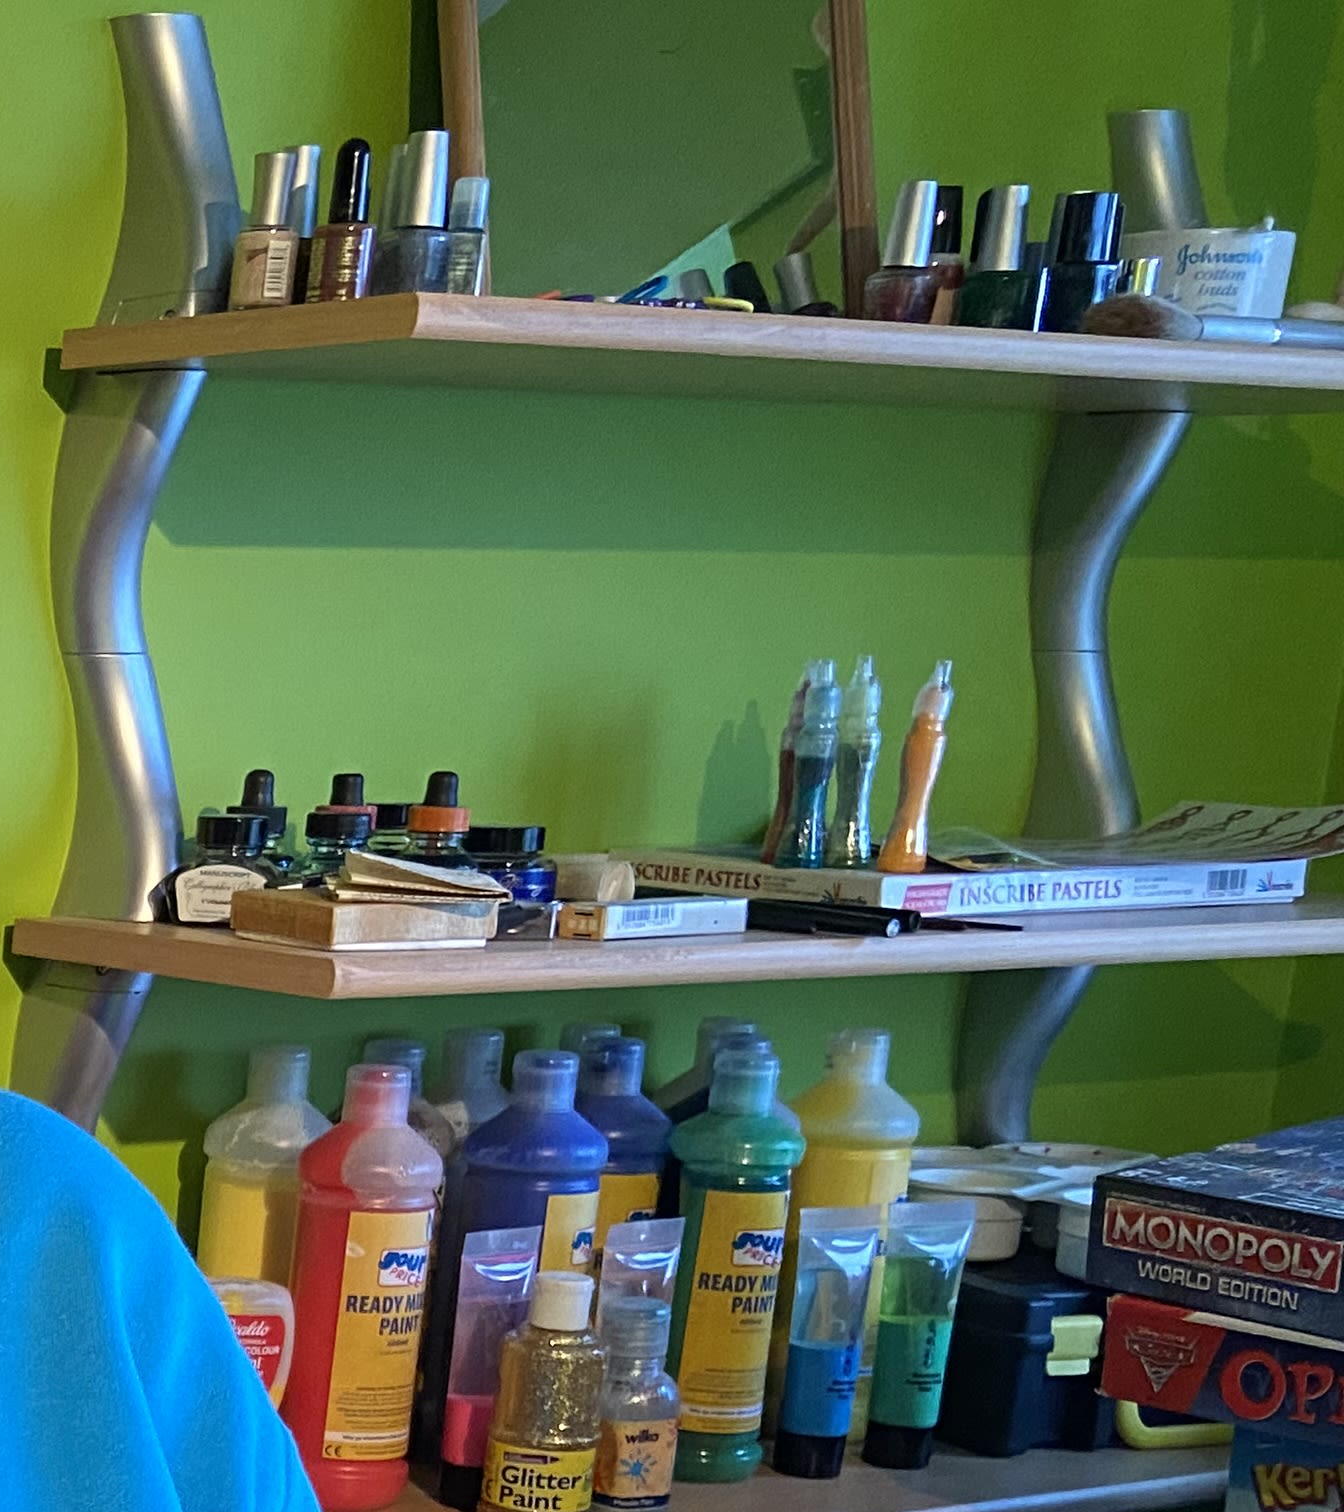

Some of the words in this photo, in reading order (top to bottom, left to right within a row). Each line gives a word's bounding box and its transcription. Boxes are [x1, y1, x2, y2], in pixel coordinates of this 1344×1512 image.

[695, 865, 762, 891] PASTELS
[960, 884, 1046, 907] INSCRIBE
[1051, 879, 1122, 900] PASTELS
[1111, 1205, 1337, 1282] MONOPOLY
[390, 1268, 424, 1288] PRICE
[698, 1273, 756, 1292] READY
[1138, 1259, 1212, 1292] WORLD
[1218, 1276, 1300, 1312] EDITION
[346, 1295, 400, 1313] READY
[731, 1296, 775, 1314] PAINT
[379, 1315, 419, 1335] PAINT
[624, 1431, 660, 1445] wilko
[500, 1466, 582, 1493] Glitter
[499, 1486, 562, 1511] Paint
